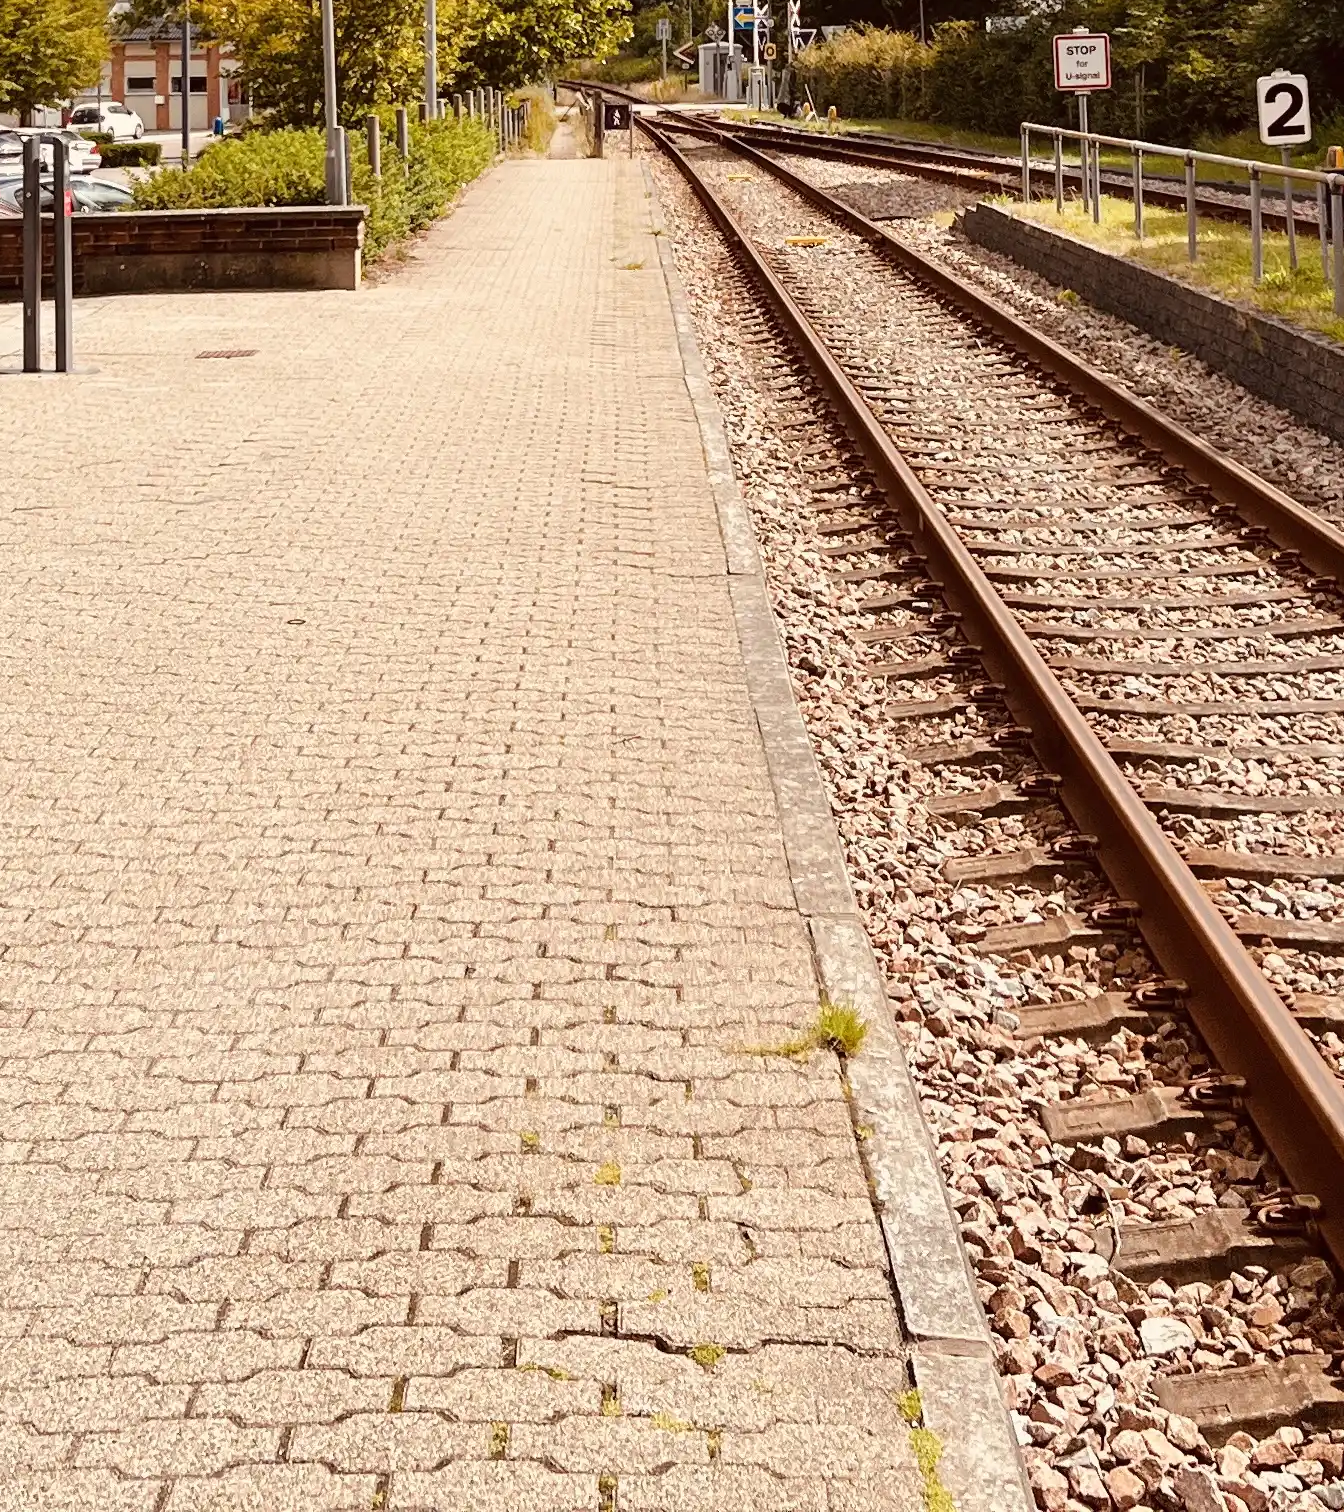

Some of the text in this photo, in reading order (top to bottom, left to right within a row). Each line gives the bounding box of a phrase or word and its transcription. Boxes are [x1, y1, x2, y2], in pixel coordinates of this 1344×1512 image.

[1066, 45, 1097, 56] STOP
[1076, 60, 1088, 68] for
[1065, 71, 1101, 81] U-signal
[1264, 82, 1306, 137] 2
